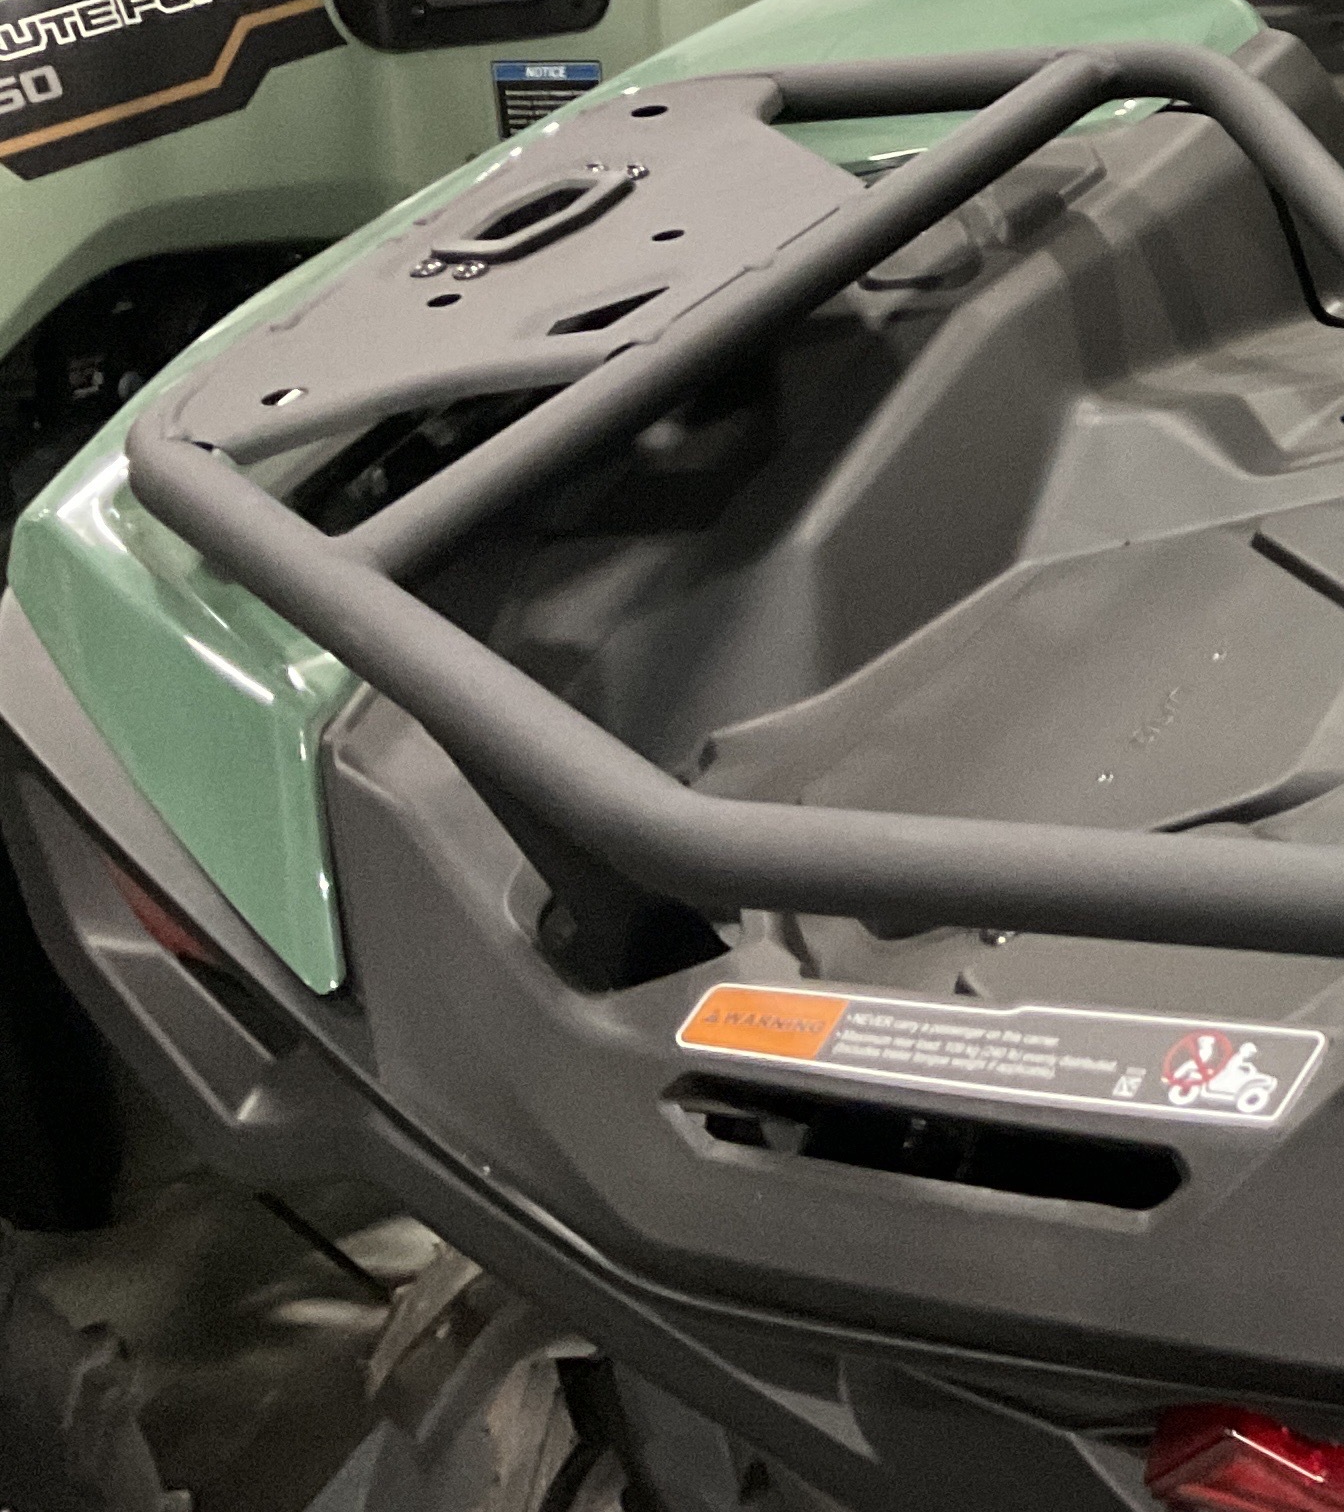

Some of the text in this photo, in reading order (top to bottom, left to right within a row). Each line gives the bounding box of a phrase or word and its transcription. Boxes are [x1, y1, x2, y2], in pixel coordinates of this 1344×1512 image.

[525, 66, 567, 79] NOTICE
[0, 65, 64, 115] 50
[724, 1011, 826, 1034] WARNING
